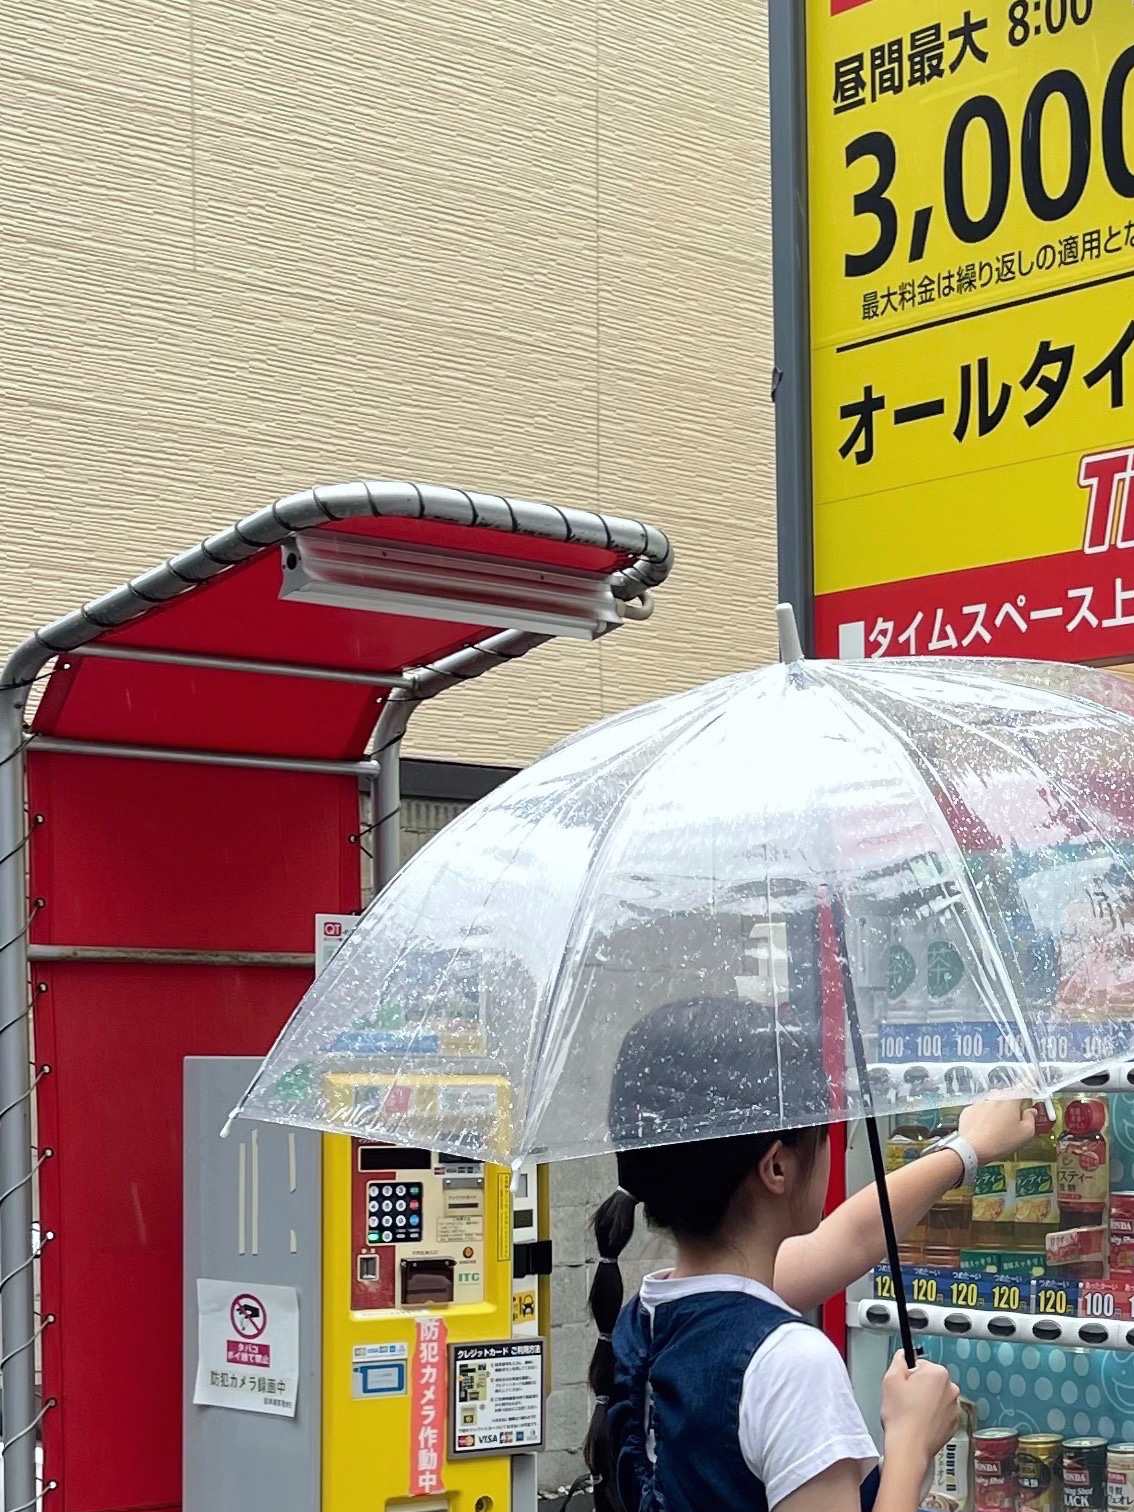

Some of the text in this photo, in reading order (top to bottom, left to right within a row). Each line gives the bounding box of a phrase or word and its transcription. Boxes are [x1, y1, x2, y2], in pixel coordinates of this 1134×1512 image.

[833, 12, 989, 114] 昼間最大
[458, 1272, 480, 1282] ITC
[457, 1346, 509, 1359] クレジットカード
[210, 1370, 286, 1395] 防犯カメラ録画中
[418, 1318, 439, 1493] 防犯カメラ作動中
[478, 1434, 498, 1444] VISA
[1063, 1494, 1090, 1508] LACK
